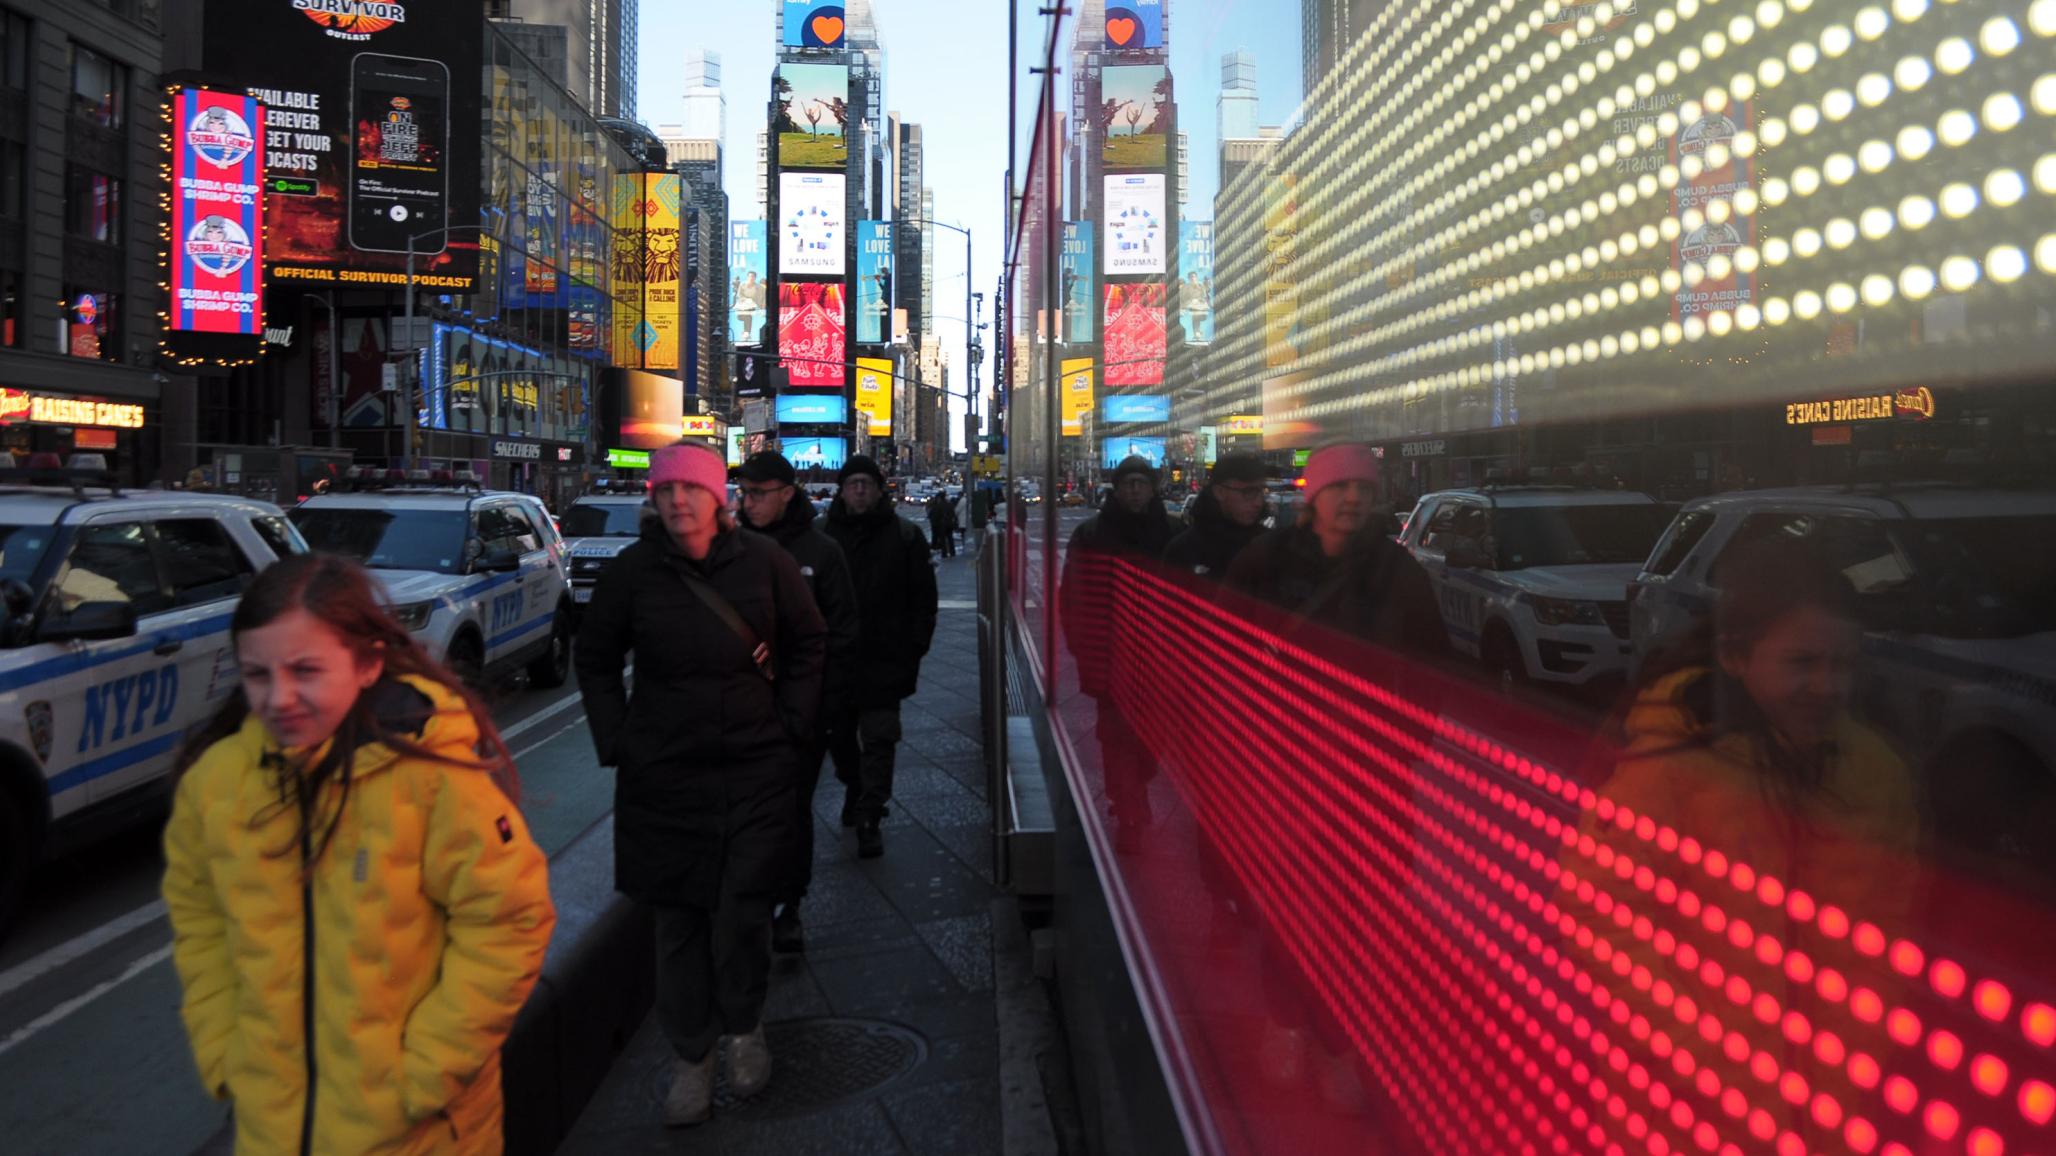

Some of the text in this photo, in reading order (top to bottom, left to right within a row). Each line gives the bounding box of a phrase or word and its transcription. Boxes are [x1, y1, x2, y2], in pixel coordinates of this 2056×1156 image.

[326, 29, 371, 41] OUTLAST
[266, 110, 320, 130] EREVER
[191, 133, 252, 149] BUBBA GUMP
[294, 133, 331, 151] YOUR
[180, 178, 260, 194] BUBBA GUMP
[185, 189, 231, 202] SHRIMP
[733, 224, 749, 238] WE
[875, 224, 890, 238] WE
[733, 239, 759, 253] LOVE
[865, 239, 890, 254] LOVE
[733, 254, 746, 268] LA
[788, 258, 836, 266] SAMSUNG
[877, 254, 890, 268] LA
[273, 267, 473, 287] OFFICIAL SURVIVOR PODCAST
[178, 288, 258, 302] BUBBA GUMP
[183, 299, 230, 311] SHRIMP
[31, 396, 144, 428] RAISING CANE'S
[495, 441, 541, 459] SKECHERS
[78, 663, 179, 753] NYPD
